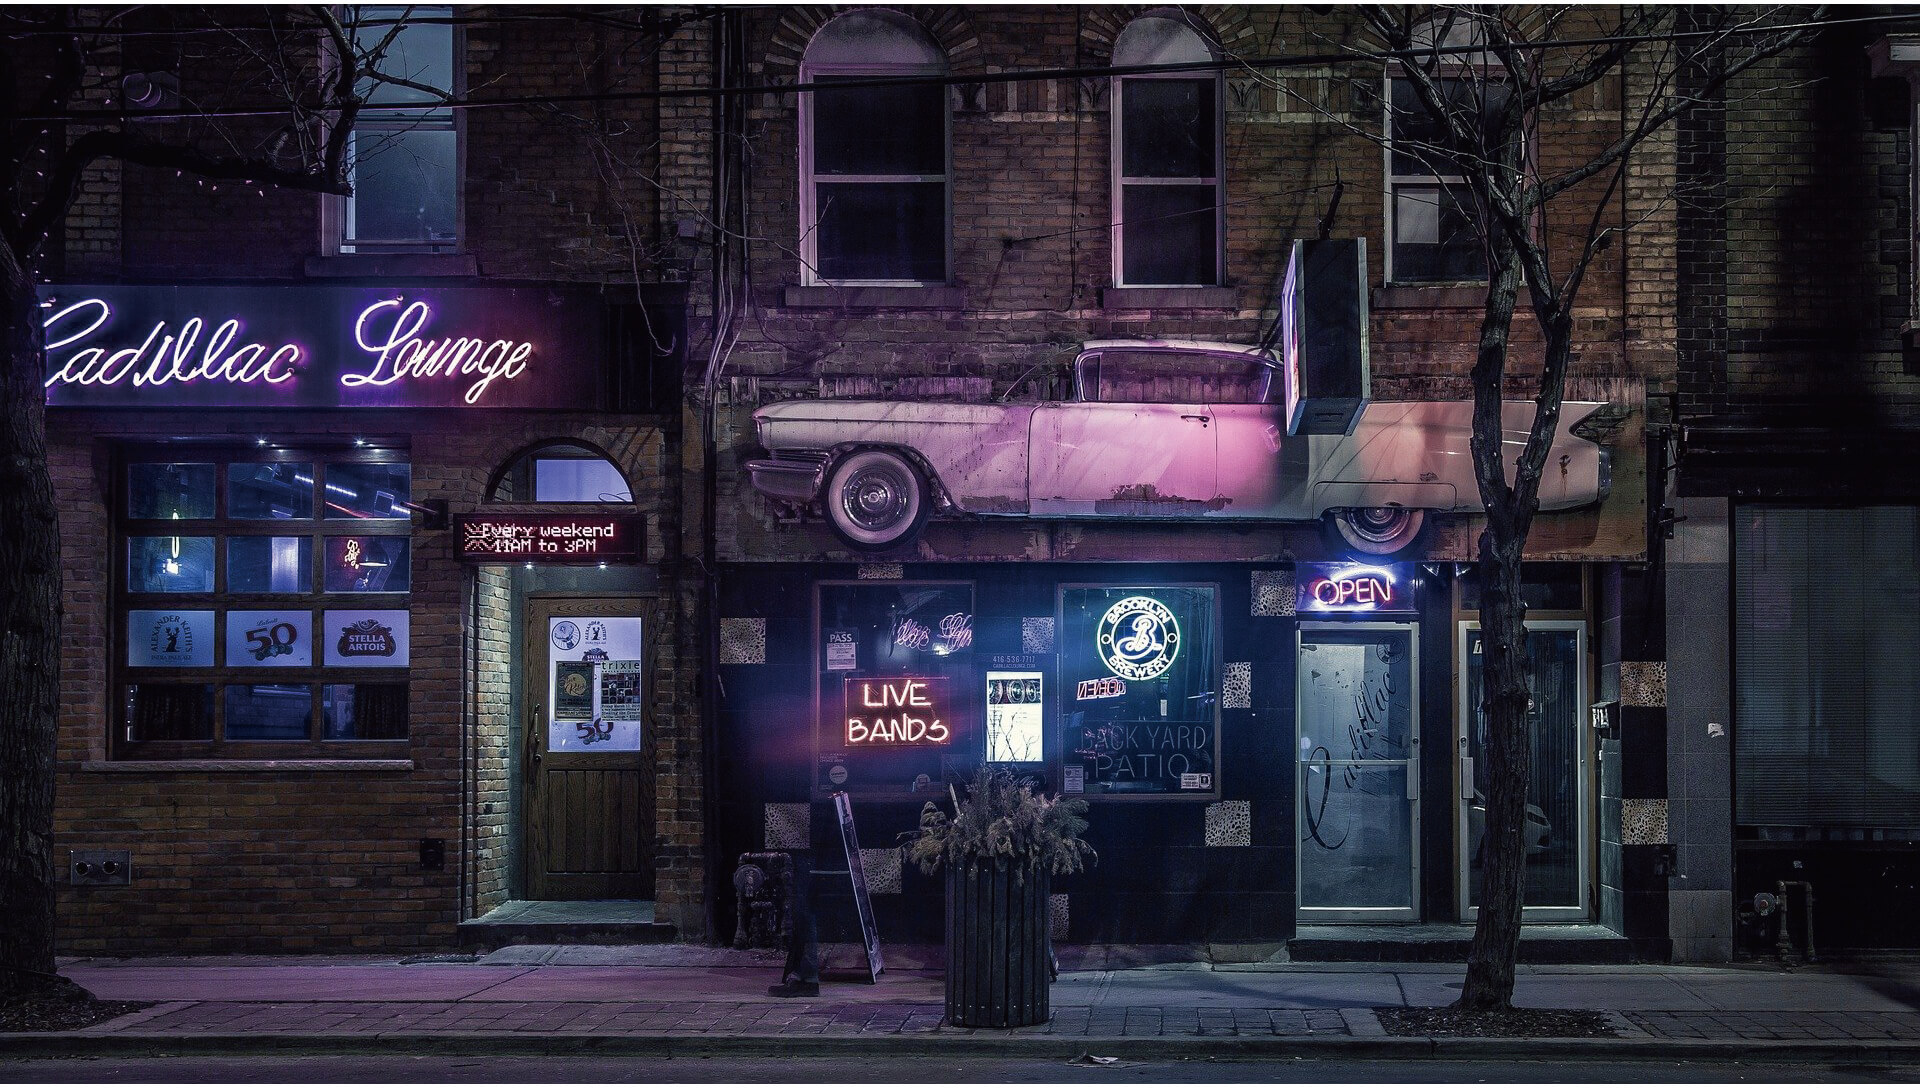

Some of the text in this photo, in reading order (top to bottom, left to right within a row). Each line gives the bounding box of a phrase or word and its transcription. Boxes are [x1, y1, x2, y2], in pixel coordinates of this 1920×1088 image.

[43, 296, 534, 404] Cadillac Lounge
[540, 523, 614, 537] weekend
[494, 539, 597, 552] 11AM to 3PM
[1315, 577, 1391, 605] OPEN
[1107, 599, 1171, 624] BROOKLYN
[245, 622, 298, 654] 50
[348, 634, 386, 643] STELLA
[348, 643, 386, 651] ARTOIS
[829, 633, 853, 643] PASS
[601, 660, 640, 670] trixie
[1108, 653, 1170, 678] BREWERY
[863, 679, 932, 707] LIVE
[848, 713, 950, 742] BANDS
[1081, 725, 1206, 751] BACK YARD
[1095, 753, 1190, 778] PATIO
